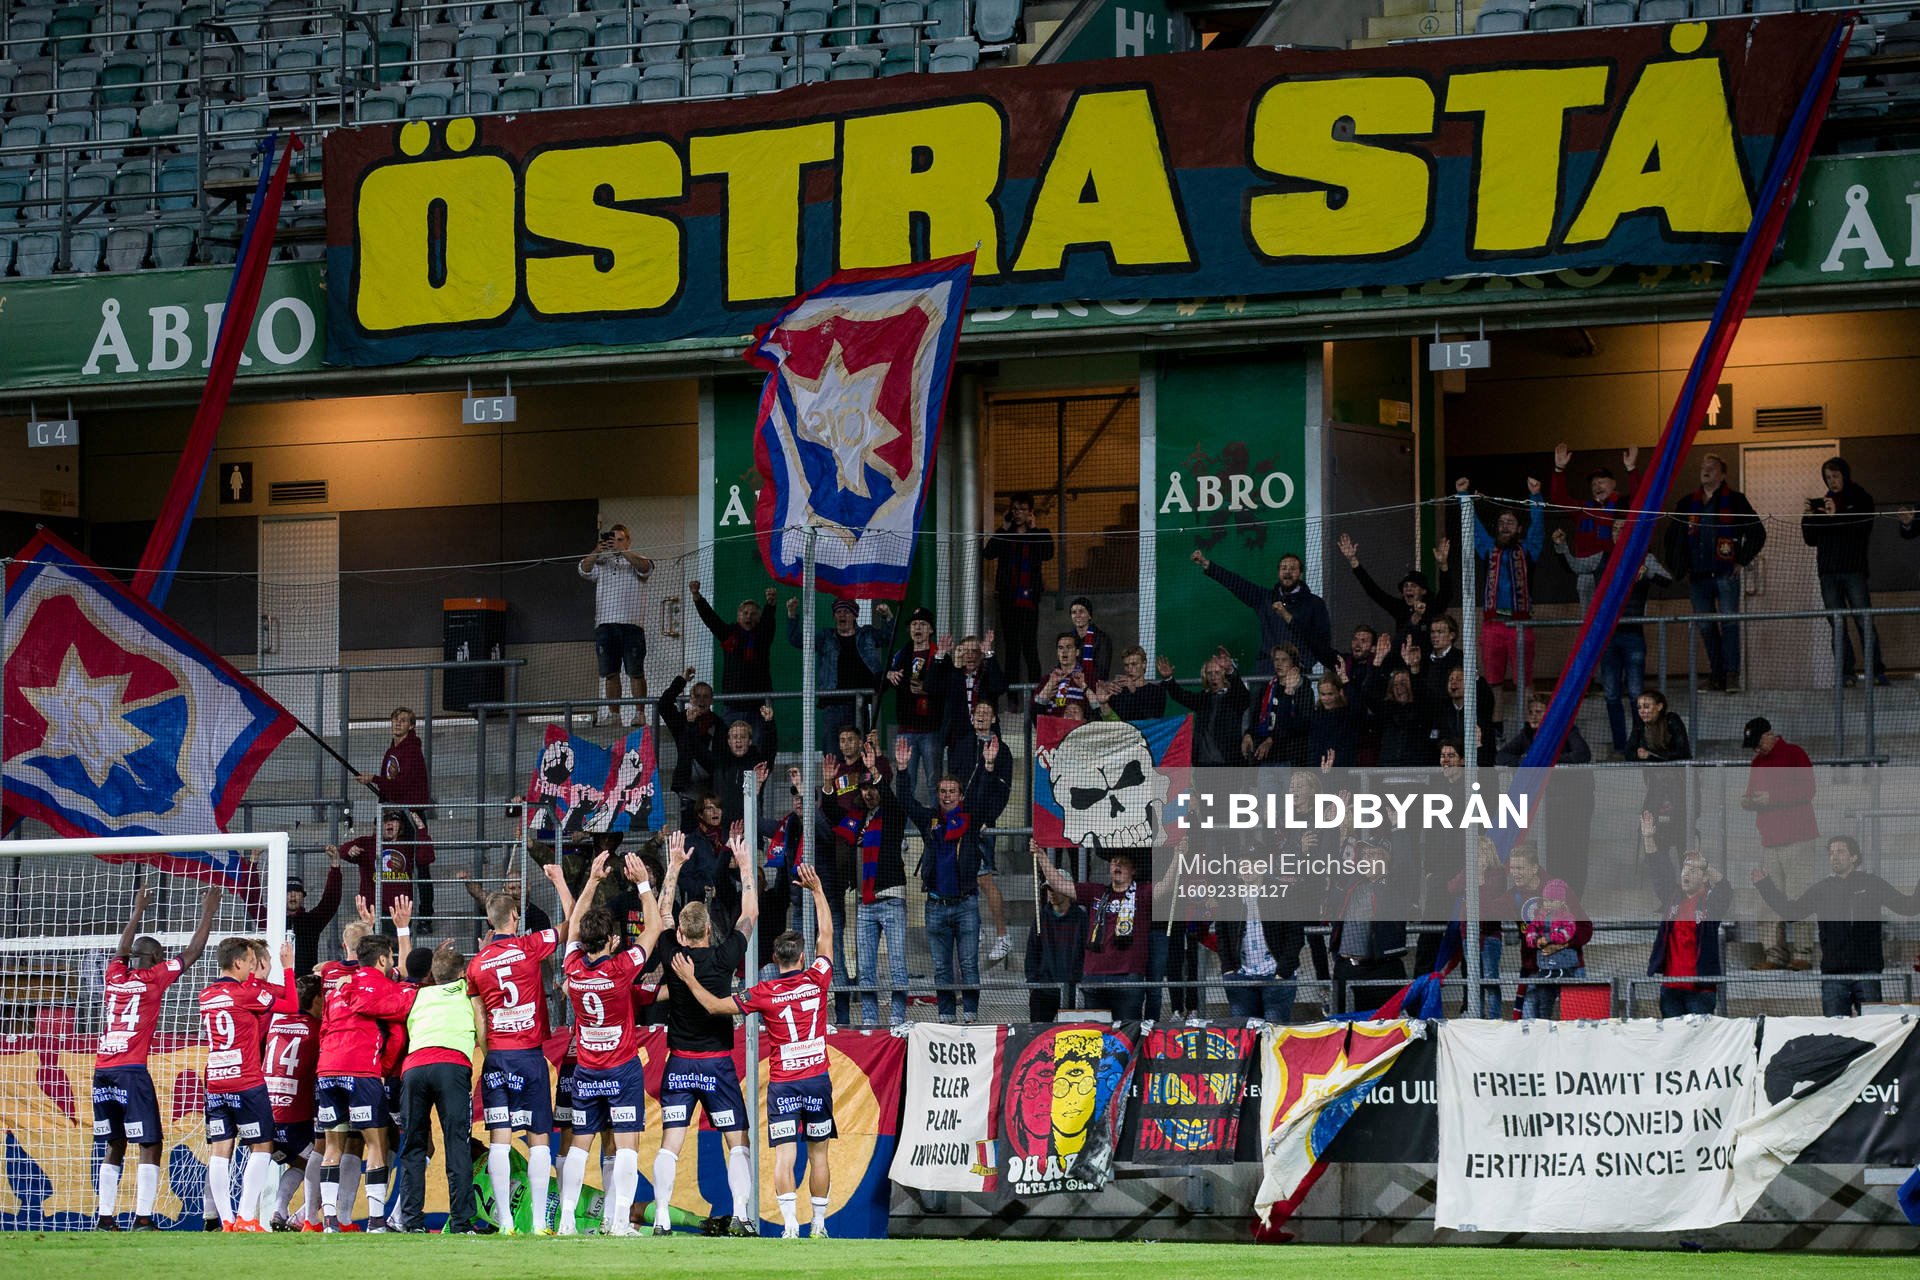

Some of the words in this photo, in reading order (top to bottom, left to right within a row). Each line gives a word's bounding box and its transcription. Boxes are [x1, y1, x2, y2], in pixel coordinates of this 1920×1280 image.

[353, 86, 1196, 334] ÖSTRA
[1247, 20, 1756, 260] STÅ
[1821, 184, 1920, 272] Å
[719, 484, 761, 526] Å
[1160, 471, 1295, 514] ÅBRO
[495, 966, 520, 1008] 5
[771, 988, 821, 1004] HAMMARVIKEN
[581, 991, 605, 1028] 9
[778, 997, 821, 1043] 17
[203, 1010, 236, 1053] 19
[928, 1040, 977, 1065] SEGER
[576, 1079, 620, 1089] Gendalen
[668, 1072, 717, 1083] Gendalen
[932, 1076, 970, 1098] ELLER
[1141, 1072, 1248, 1105] MODERN
[1472, 1071, 1547, 1098] FREE
[1555, 1070, 1645, 1096] DAWIT
[1655, 1063, 1744, 1096] ISAAK
[1855, 1078, 1900, 1103] evi
[268, 1095, 294, 1105] RIG
[351, 1111, 371, 1120] ASTA
[926, 1109, 962, 1131] PLAN-
[1502, 1109, 1684, 1138] IMPRISONED
[1693, 1106, 1723, 1133] IN
[910, 1142, 970, 1167] INVASION
[1464, 1152, 1586, 1179] ERITREA
[1595, 1149, 1686, 1178] SINCE
[1015, 1180, 1062, 1195] ULTRAS
